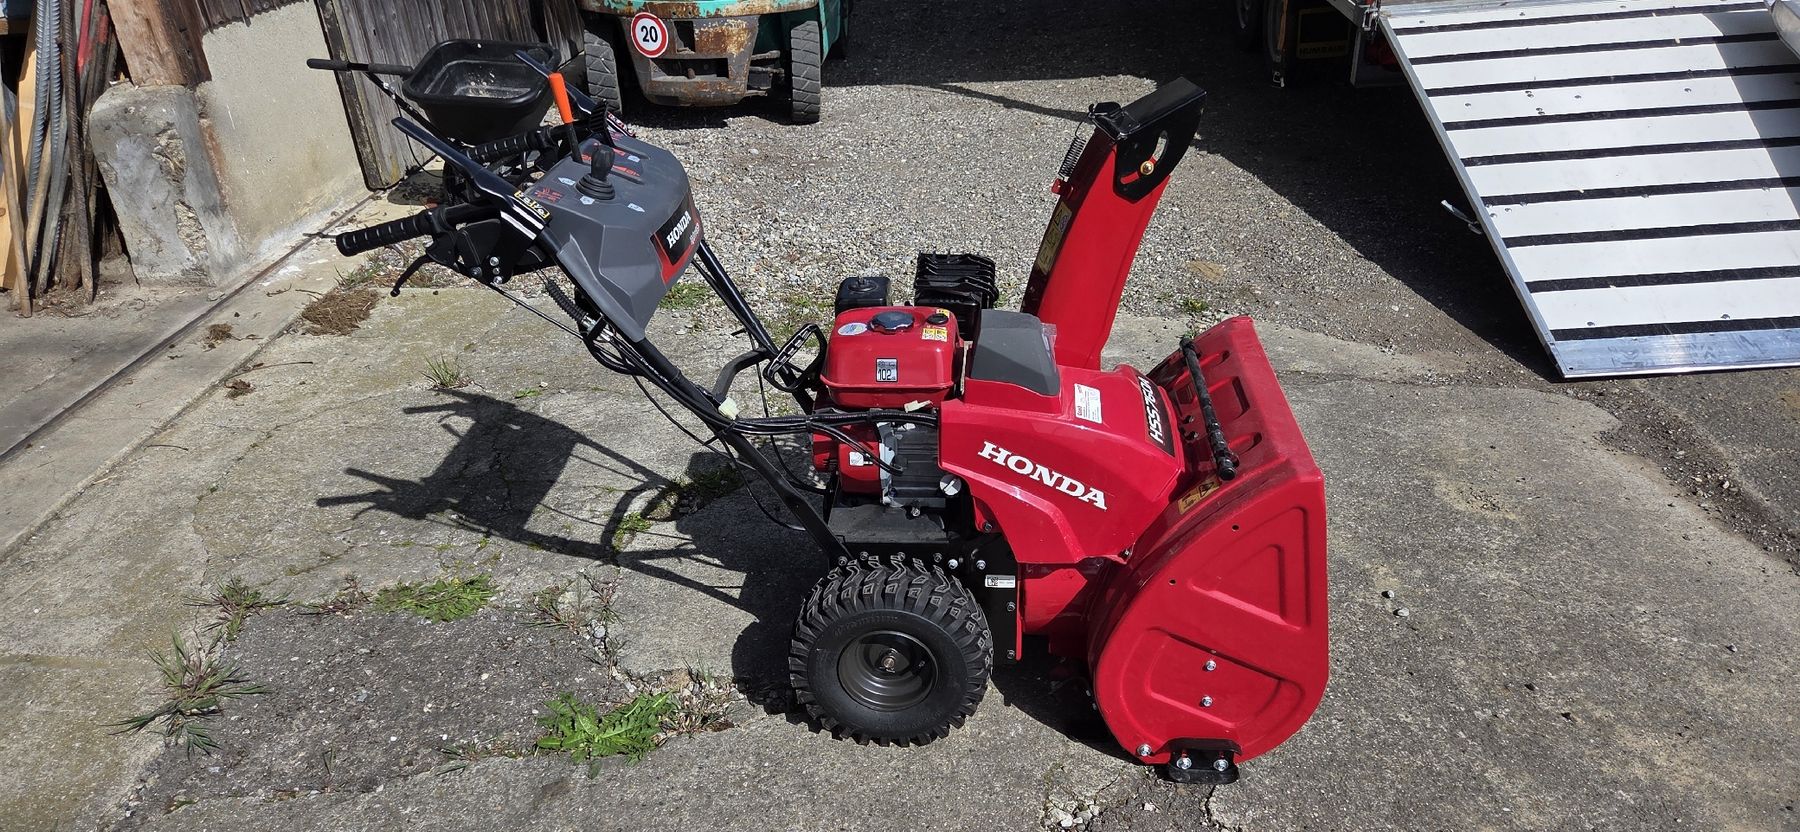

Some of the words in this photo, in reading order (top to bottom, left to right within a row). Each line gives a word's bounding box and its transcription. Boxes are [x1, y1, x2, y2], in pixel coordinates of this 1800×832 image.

[641, 25, 658, 43] 20
[666, 210, 692, 249] HONDA
[878, 368, 892, 381] 102
[978, 440, 1107, 510] HONDA
